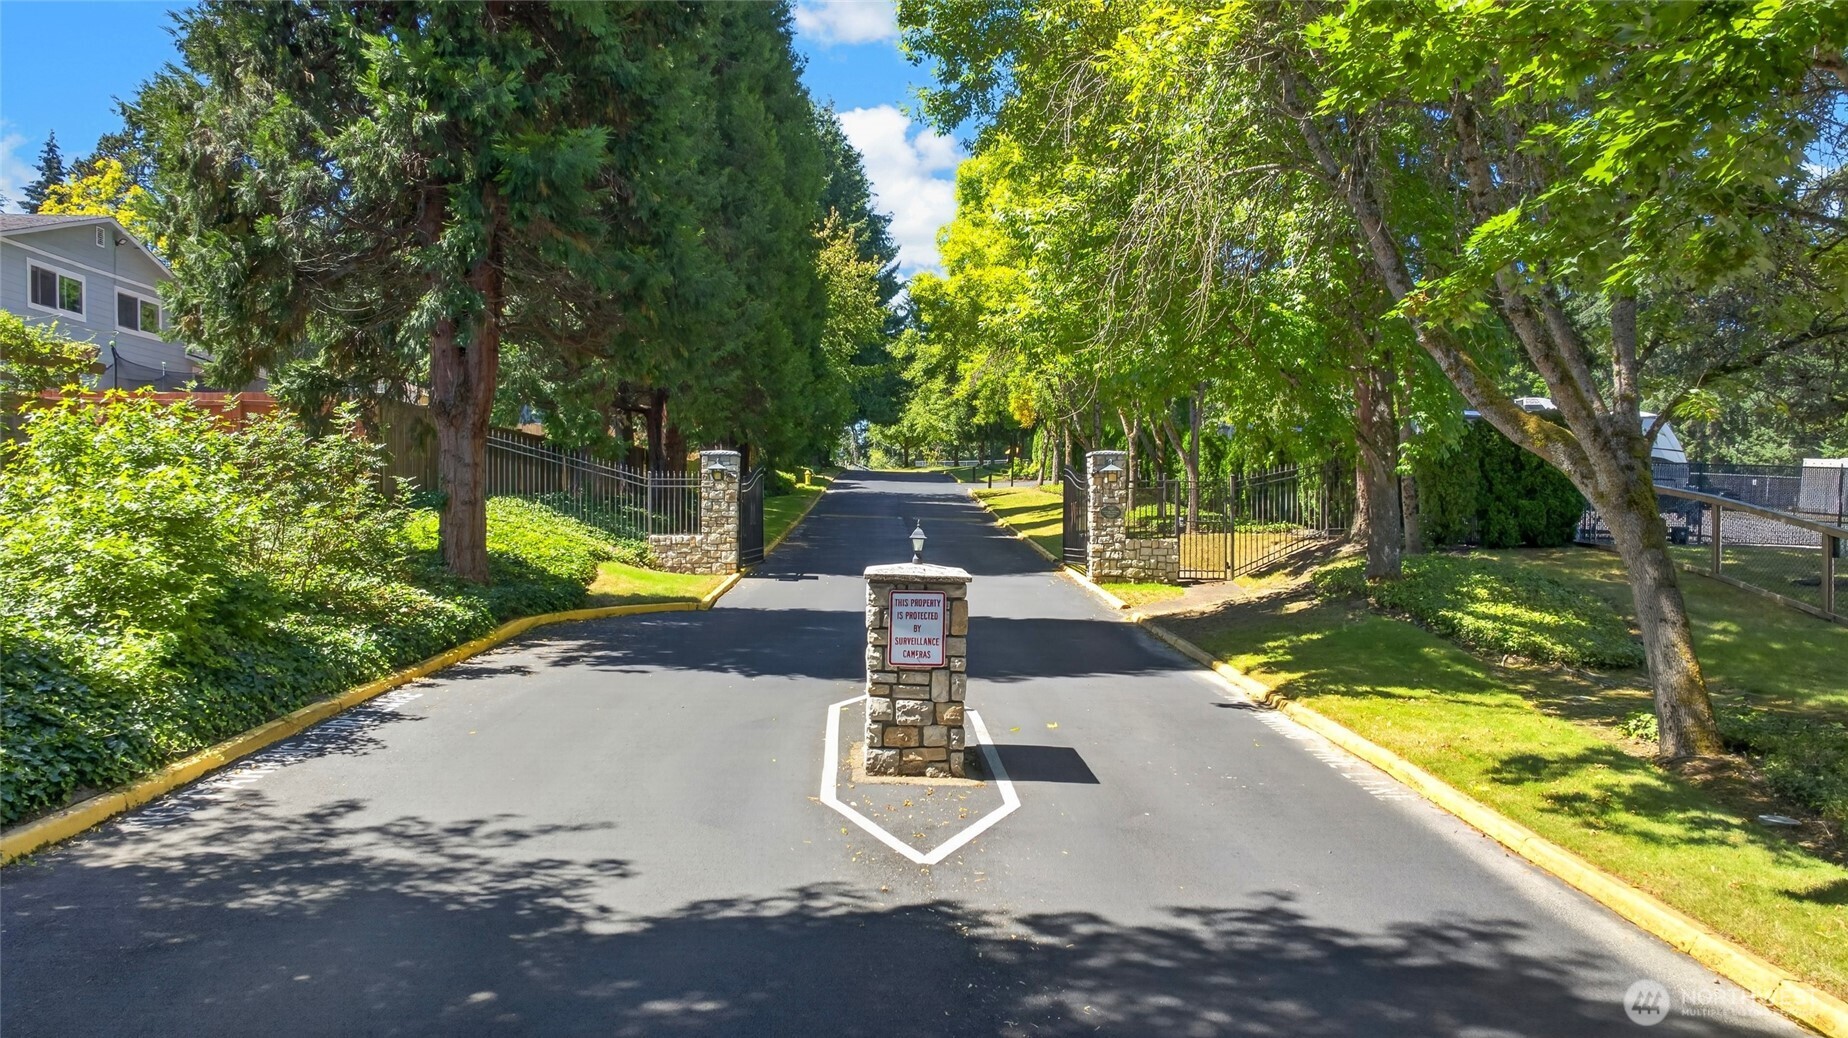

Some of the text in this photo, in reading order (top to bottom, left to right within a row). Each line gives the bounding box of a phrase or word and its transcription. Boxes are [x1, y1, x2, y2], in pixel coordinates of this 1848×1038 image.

[895, 599, 941, 608] THIS PROPERTY
[897, 611, 939, 620] IS PROTECTED
[913, 624, 922, 633] BY
[894, 637, 940, 646] SURVEILLANCE
[903, 650, 931, 659] CAMERAS
